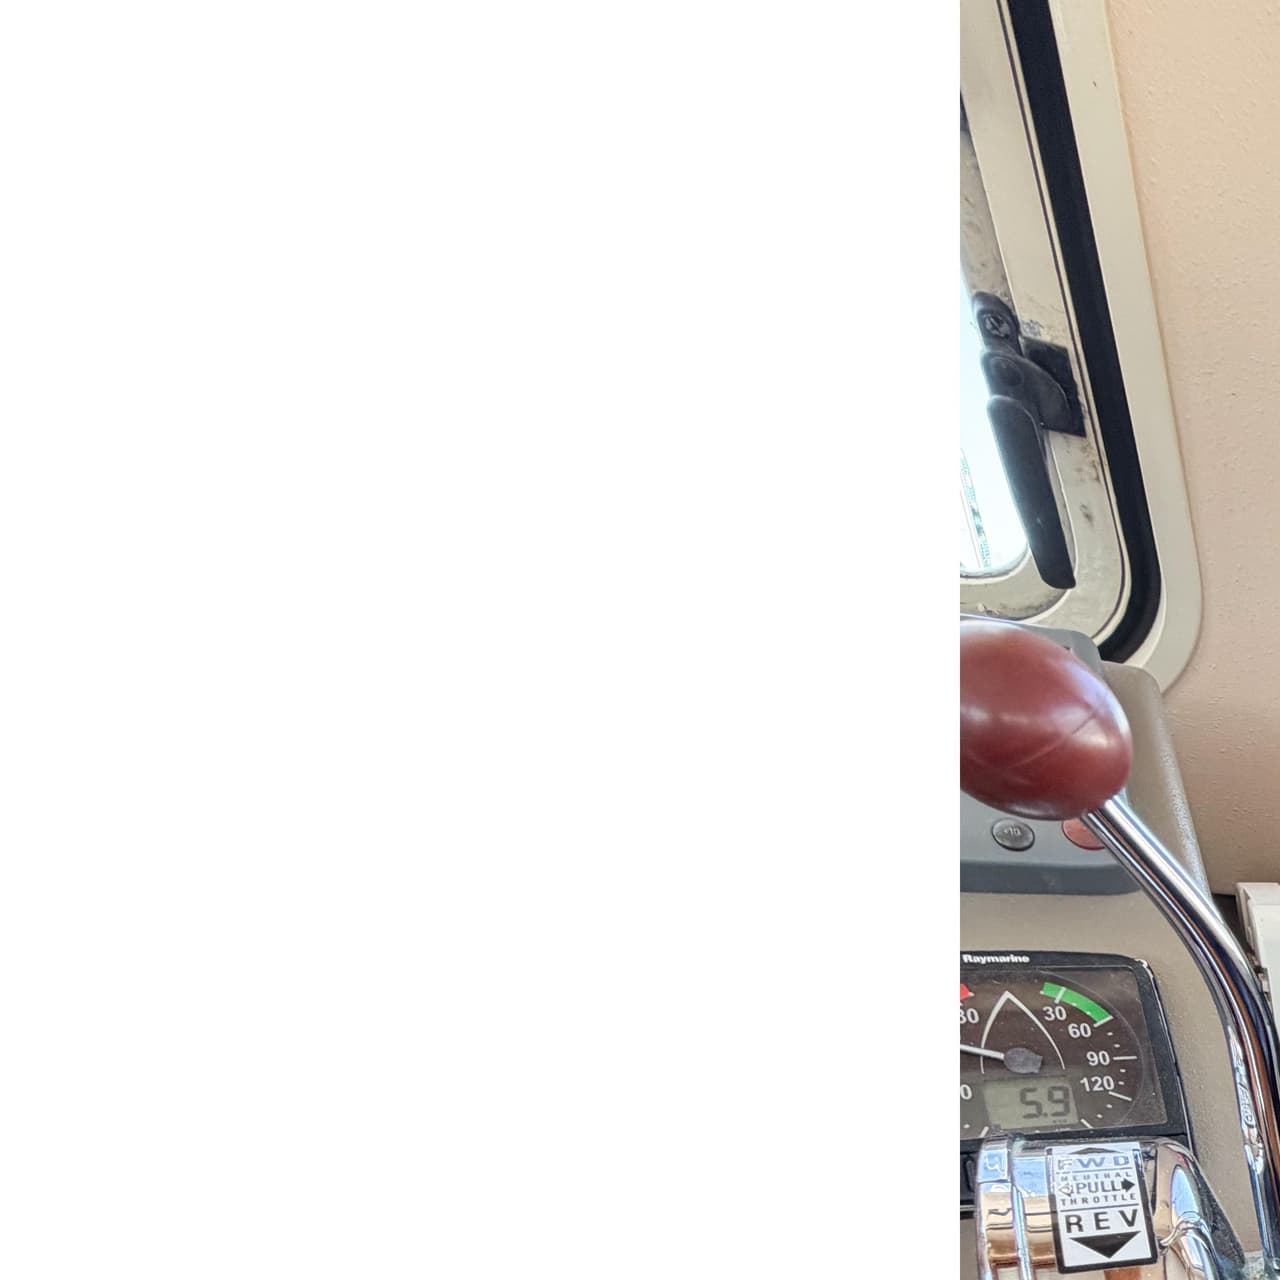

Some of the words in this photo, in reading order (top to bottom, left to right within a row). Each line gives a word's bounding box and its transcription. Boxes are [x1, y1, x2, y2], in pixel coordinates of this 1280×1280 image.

[962, 954, 1030, 965] Raymarine
[1042, 1006, 1067, 1021] 30
[1068, 1023, 1091, 1038] 60
[1086, 1051, 1110, 1066] 90
[1080, 1075, 1115, 1092] 120
[1020, 1085, 1071, 1119] 5.9
[1057, 1155, 1130, 1170] FWD
[1075, 1180, 1121, 1194] PULL
[1060, 1193, 1137, 1206] THROTTLE
[1064, 1209, 1138, 1233] REV
